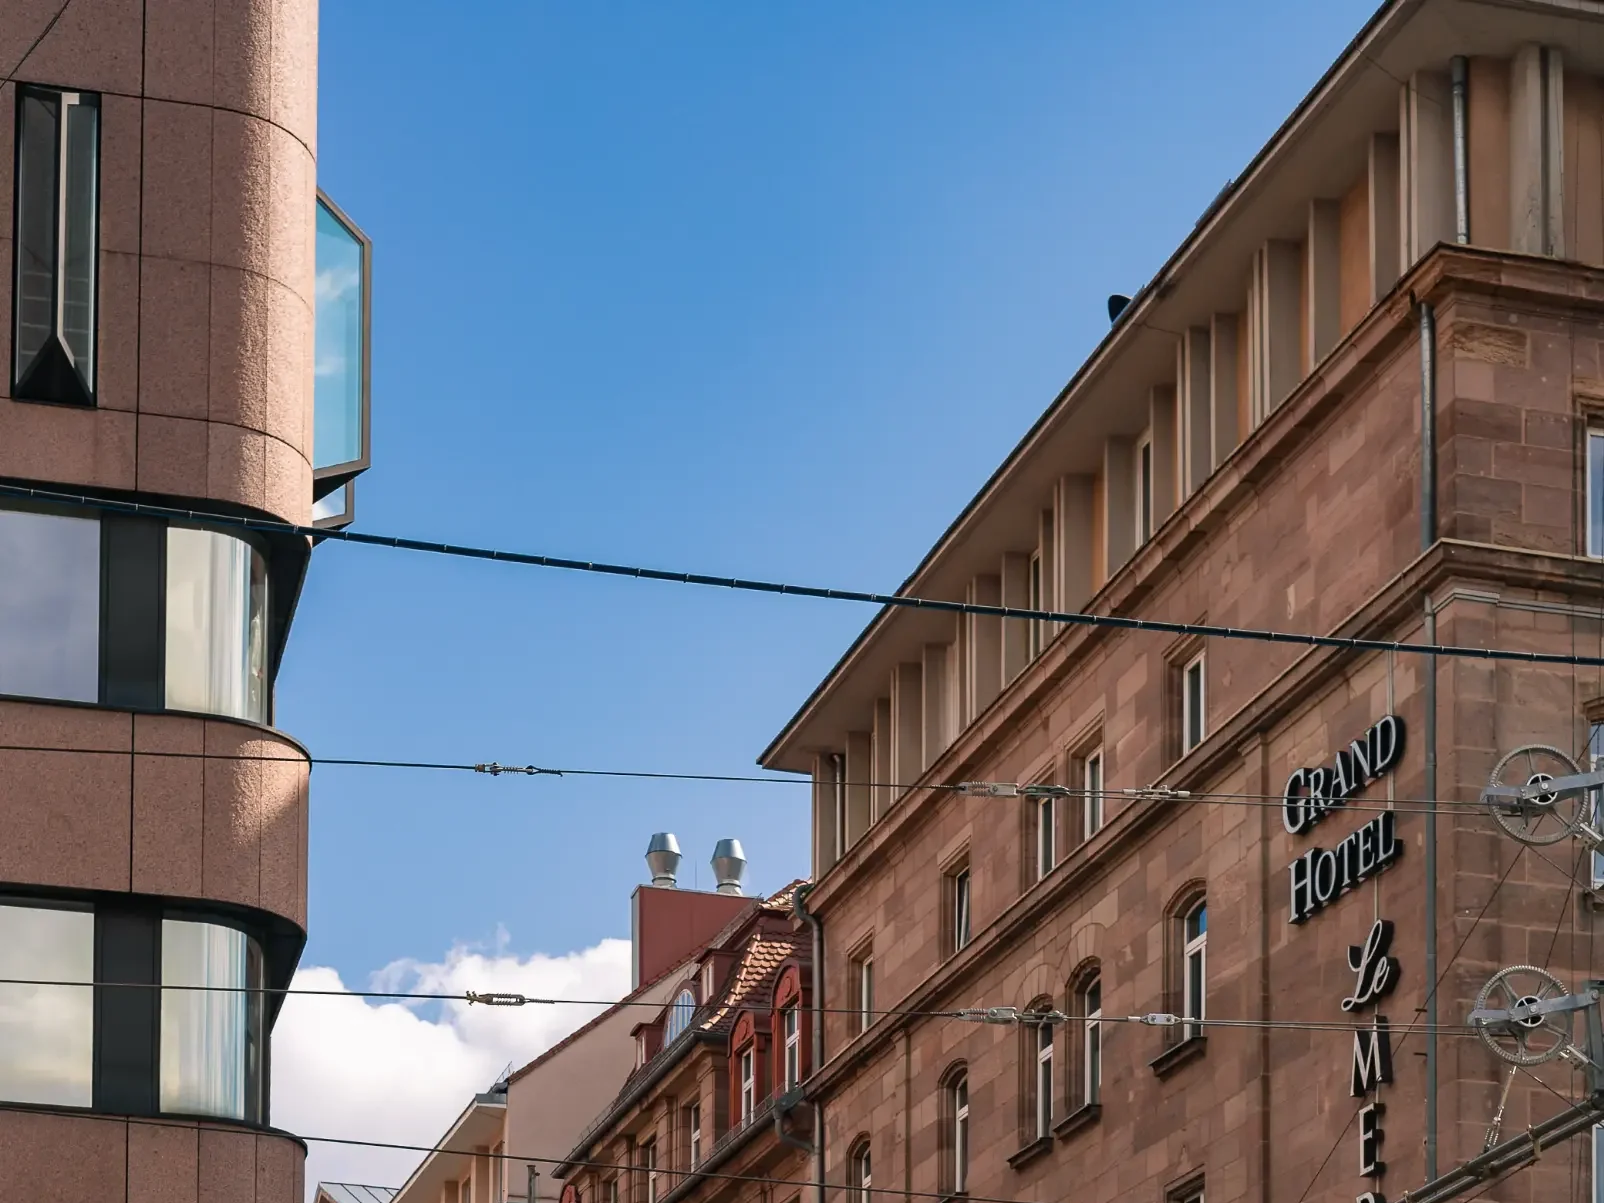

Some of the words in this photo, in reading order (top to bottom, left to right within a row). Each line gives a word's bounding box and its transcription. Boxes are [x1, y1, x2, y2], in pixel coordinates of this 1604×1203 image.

[1282, 714, 1404, 835] GRAND
[1288, 811, 1403, 923] HOTEL
[1341, 919, 1399, 1012] Le
